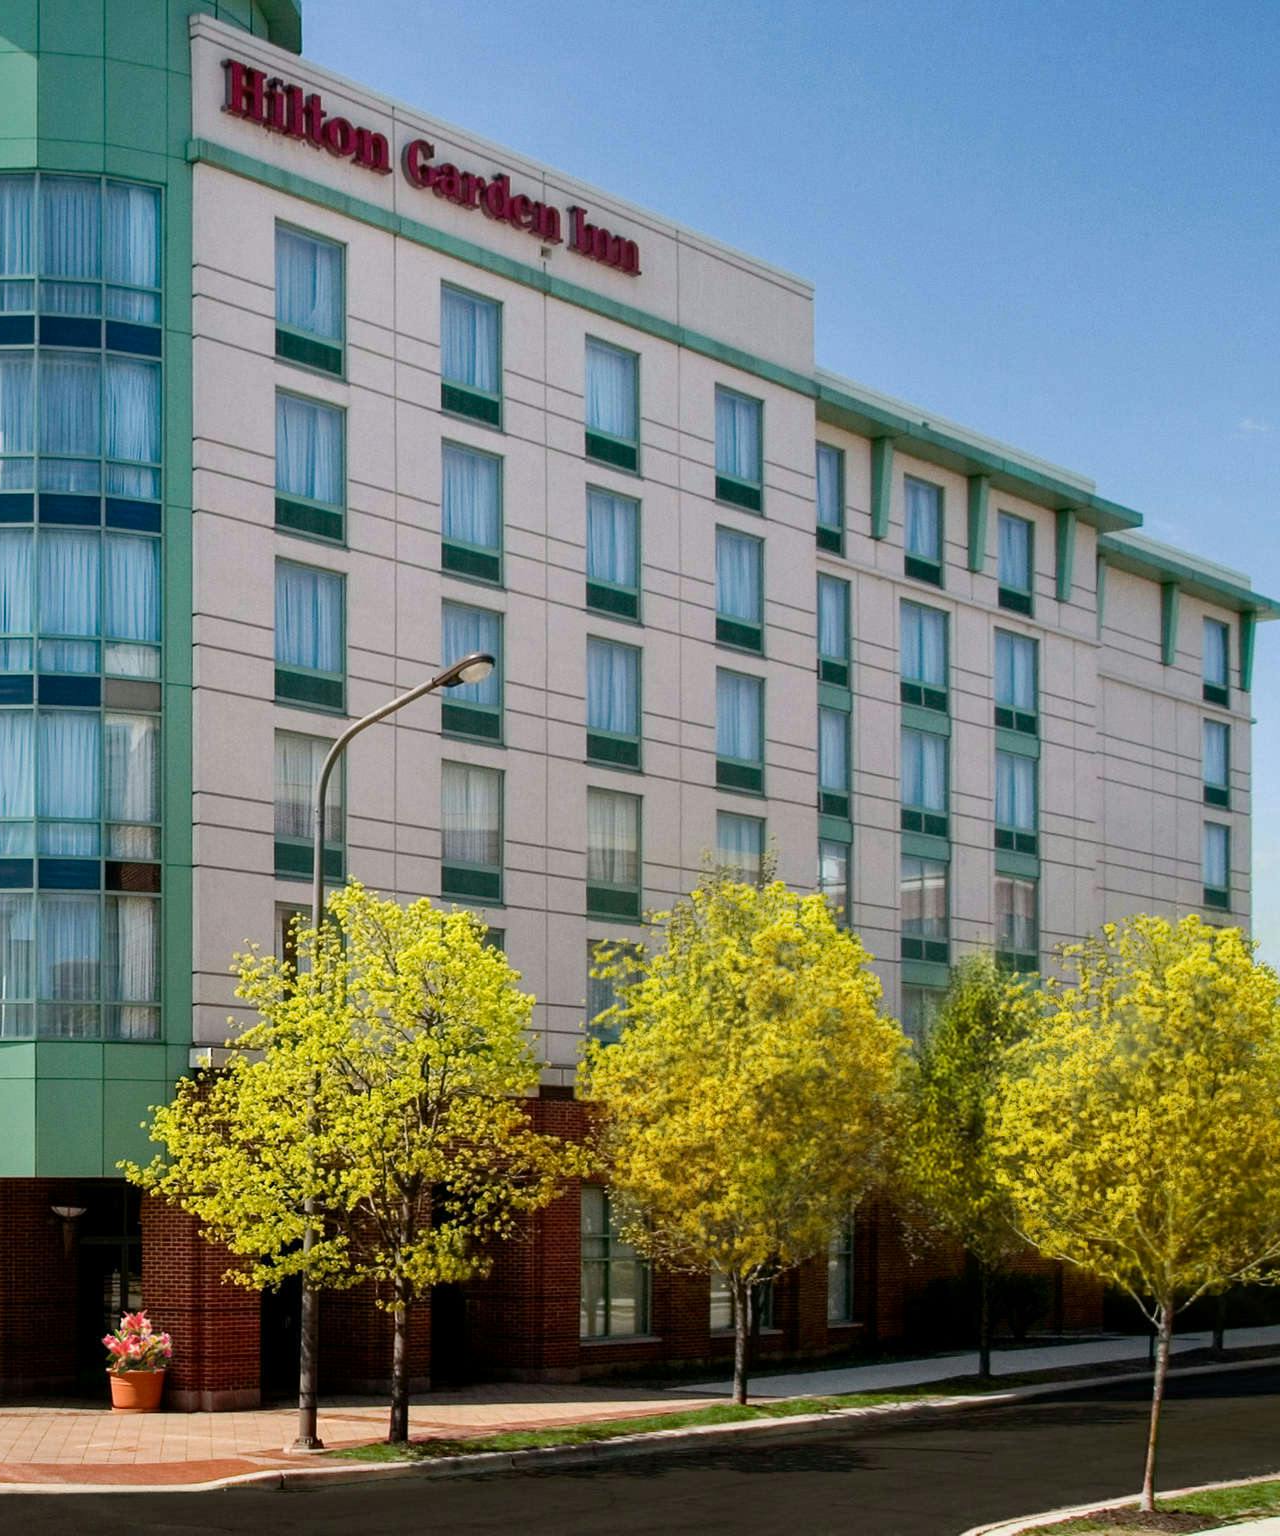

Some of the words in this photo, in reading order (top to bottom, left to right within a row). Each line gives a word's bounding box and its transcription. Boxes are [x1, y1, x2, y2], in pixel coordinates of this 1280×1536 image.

[221, 59, 392, 175] Hilton
[402, 139, 563, 245] Garden
[566, 206, 641, 276] Inn
